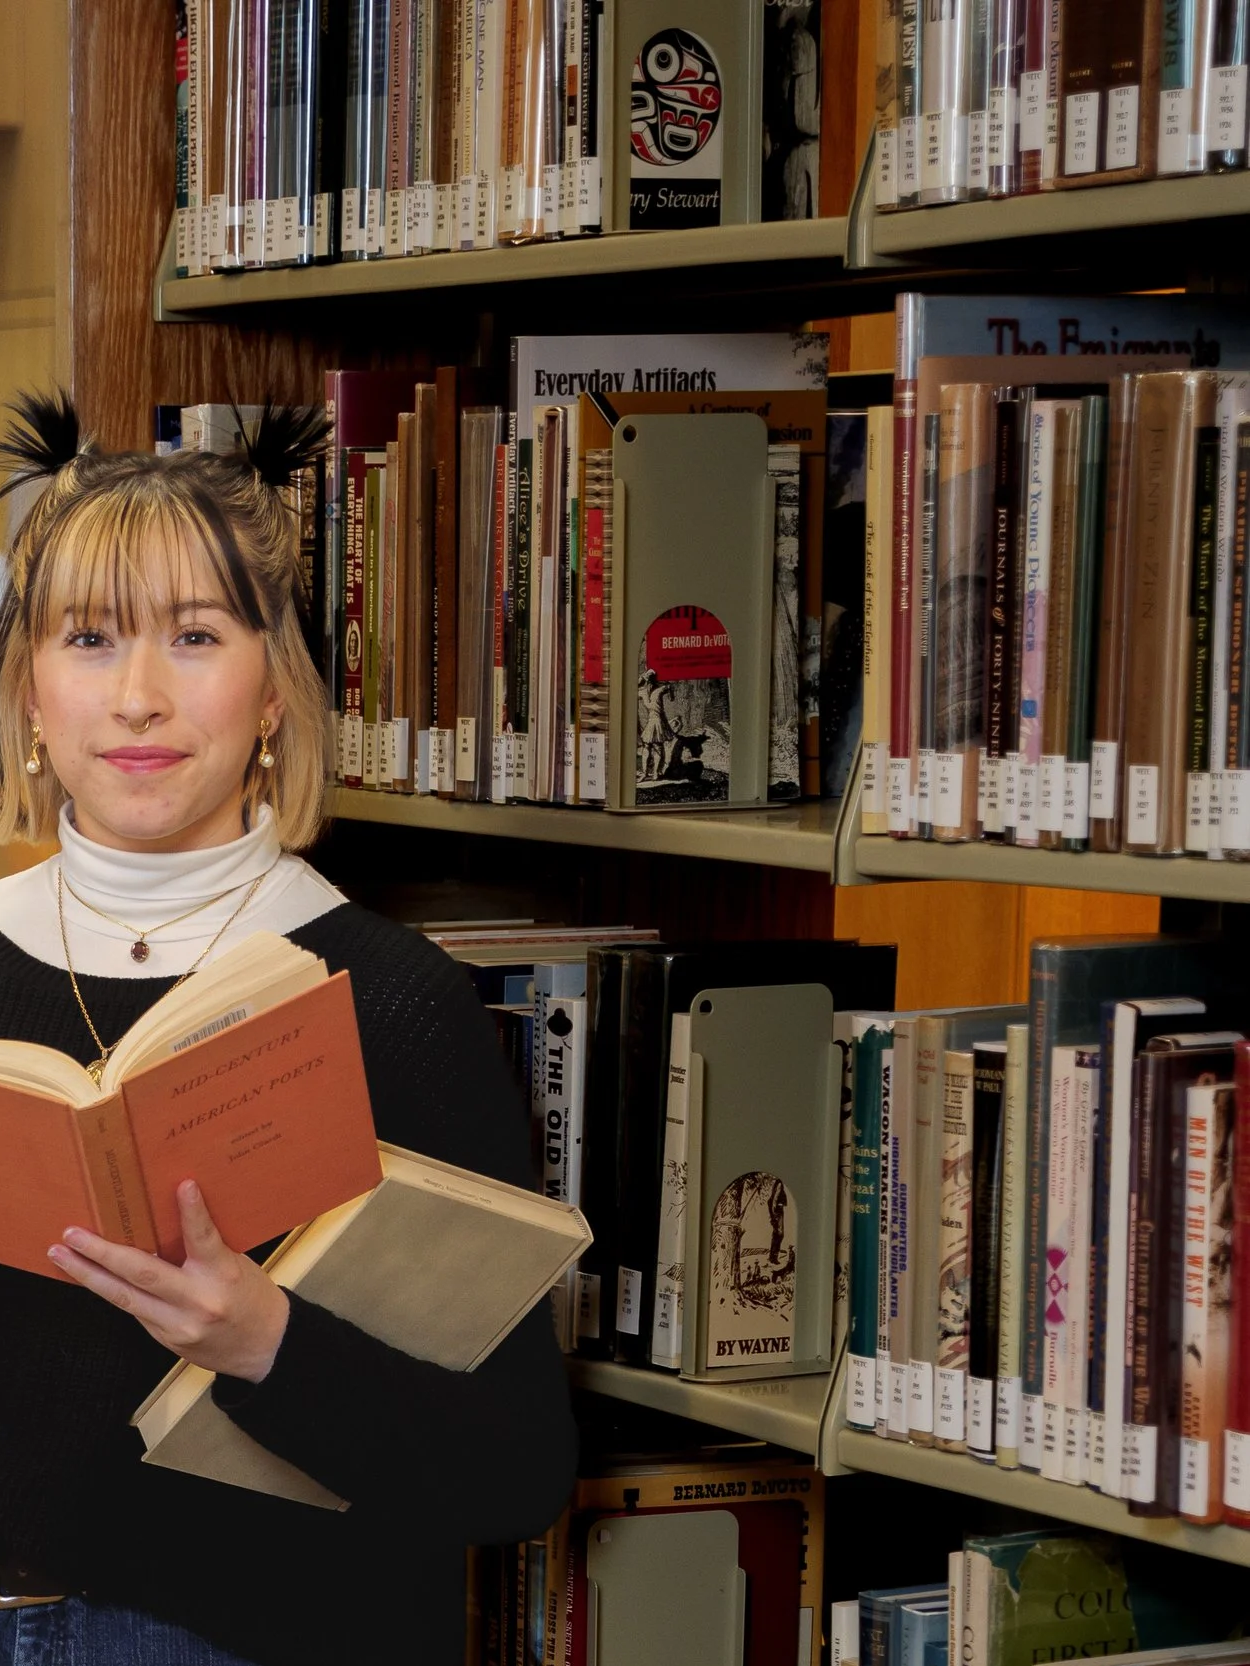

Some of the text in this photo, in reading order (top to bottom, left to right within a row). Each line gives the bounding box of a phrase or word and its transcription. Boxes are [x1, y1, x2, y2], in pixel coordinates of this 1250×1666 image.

[416, 11, 424, 77] Americas
[902, 23, 916, 69] WEST
[1026, 73, 1041, 81] WETC
[1219, 69, 1237, 77] WETC
[189, 6, 197, 188] HIGHLY EFFECTIVE PEOPLE
[392, 20, 403, 144] Vanguard Brigade
[1074, 95, 1090, 103] WETC
[1115, 88, 1130, 96] WETC
[1166, 90, 1181, 98] WETC
[656, 187, 720, 209] Stewart
[987, 318, 1048, 355] The
[534, 367, 717, 398] Everyday Artifacts
[508, 412, 517, 515] Everyday Artifacts
[1218, 415, 1230, 533] Into Western
[346, 477, 356, 604] EVERYTHING THAT IS
[355, 497, 364, 584] THE HEART OF
[518, 467, 530, 611] Alice's Drive
[901, 450, 910, 584] Overland California
[1025, 414, 1043, 651] Stories Young Pioneers
[495, 458, 503, 660] BRET HARTE'S GOLD RUSH
[995, 507, 1007, 602] JOURNALS
[864, 520, 874, 676] The Look Elephant
[919, 602, 932, 657] Tennessee
[1196, 504, 1211, 712] The March the Mounted
[662, 635, 702, 649] BERNARD
[170, 1025, 305, 1099] MID-CENTURY
[533, 989, 541, 1102] HORIZON
[548, 1046, 563, 1096] THE
[165, 1056, 326, 1141] AMERICAN POETS
[547, 1109, 562, 1165] OLD
[880, 1065, 890, 1235] WAGON TRACKS
[1001, 1095, 1015, 1323] SUCCESS DEPENDS THE
[1027, 999, 1047, 1382] Historic Western Emigrant Trails
[1185, 1117, 1207, 1308] MEN OF THE WEST
[890, 1245, 898, 1318] VIGILANTES
[1135, 1221, 1155, 1377] CHILDREN THE
[715, 1336, 791, 1356] BY WAYNE
[853, 1359, 867, 1368] WETC
[939, 1372, 954, 1381] WETC
[673, 1482, 746, 1501] BERNARD
[547, 1637, 556, 1660] THE
[548, 1590, 558, 1634] ACROSS
[565, 1621, 573, 1656] SKETCH
